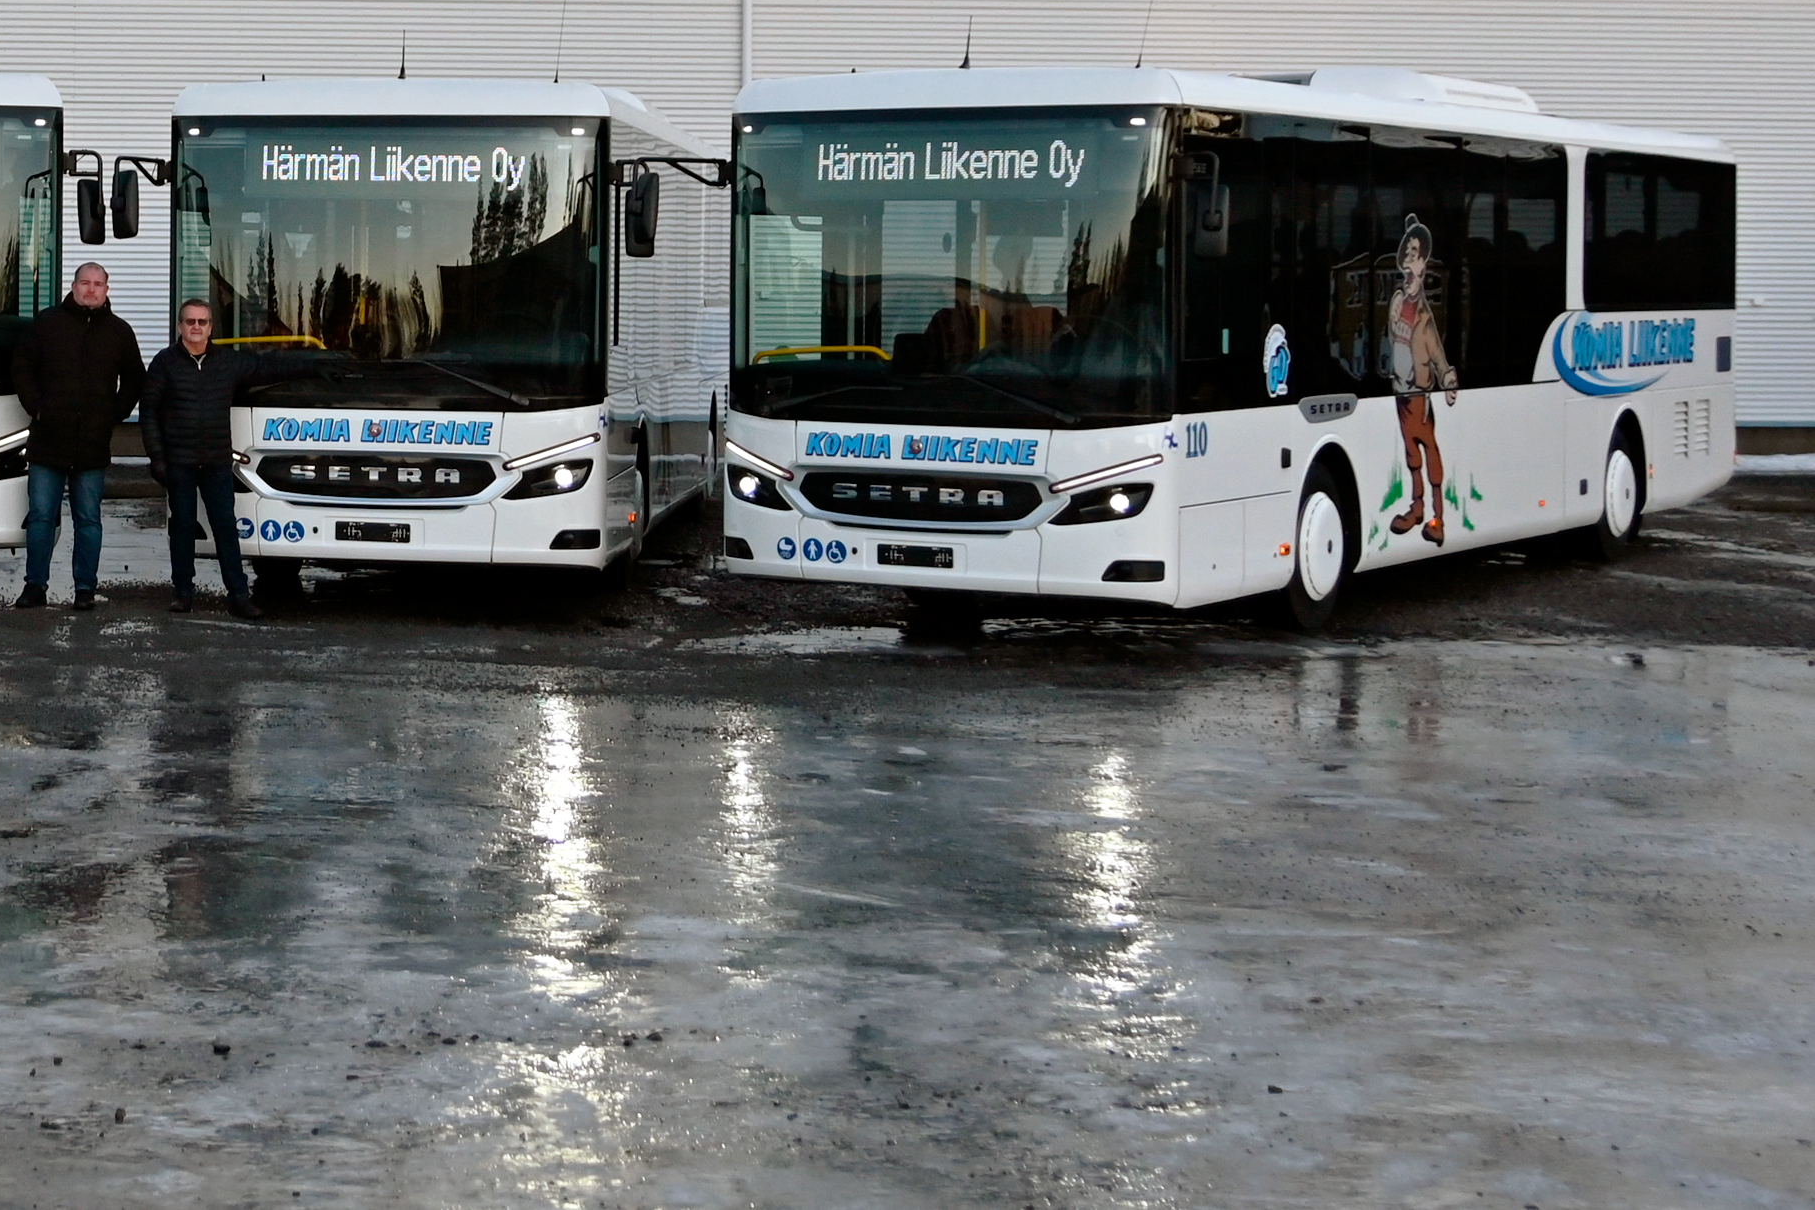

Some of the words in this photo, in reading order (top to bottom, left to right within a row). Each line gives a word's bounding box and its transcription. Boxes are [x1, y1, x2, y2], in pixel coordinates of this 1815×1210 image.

[262, 145, 360, 181] Härmän
[370, 146, 481, 182] Liikenne
[491, 147, 526, 191] Oy
[817, 143, 915, 181] Härmän
[924, 141, 1038, 180] Liikenne
[1048, 140, 1085, 188] Oy
[1572, 321, 1623, 371] KOMIA
[1628, 318, 1695, 367] LIIKENNE
[1310, 402, 1351, 415] SETRA
[262, 417, 350, 442] KOMIA
[360, 418, 493, 445] LIIKENNE
[805, 431, 891, 458] KOMIA
[901, 434, 1038, 465] LIIKENNE
[1186, 421, 1208, 458] 110
[289, 464, 460, 484] SETRA
[832, 482, 1004, 507] SETRA
